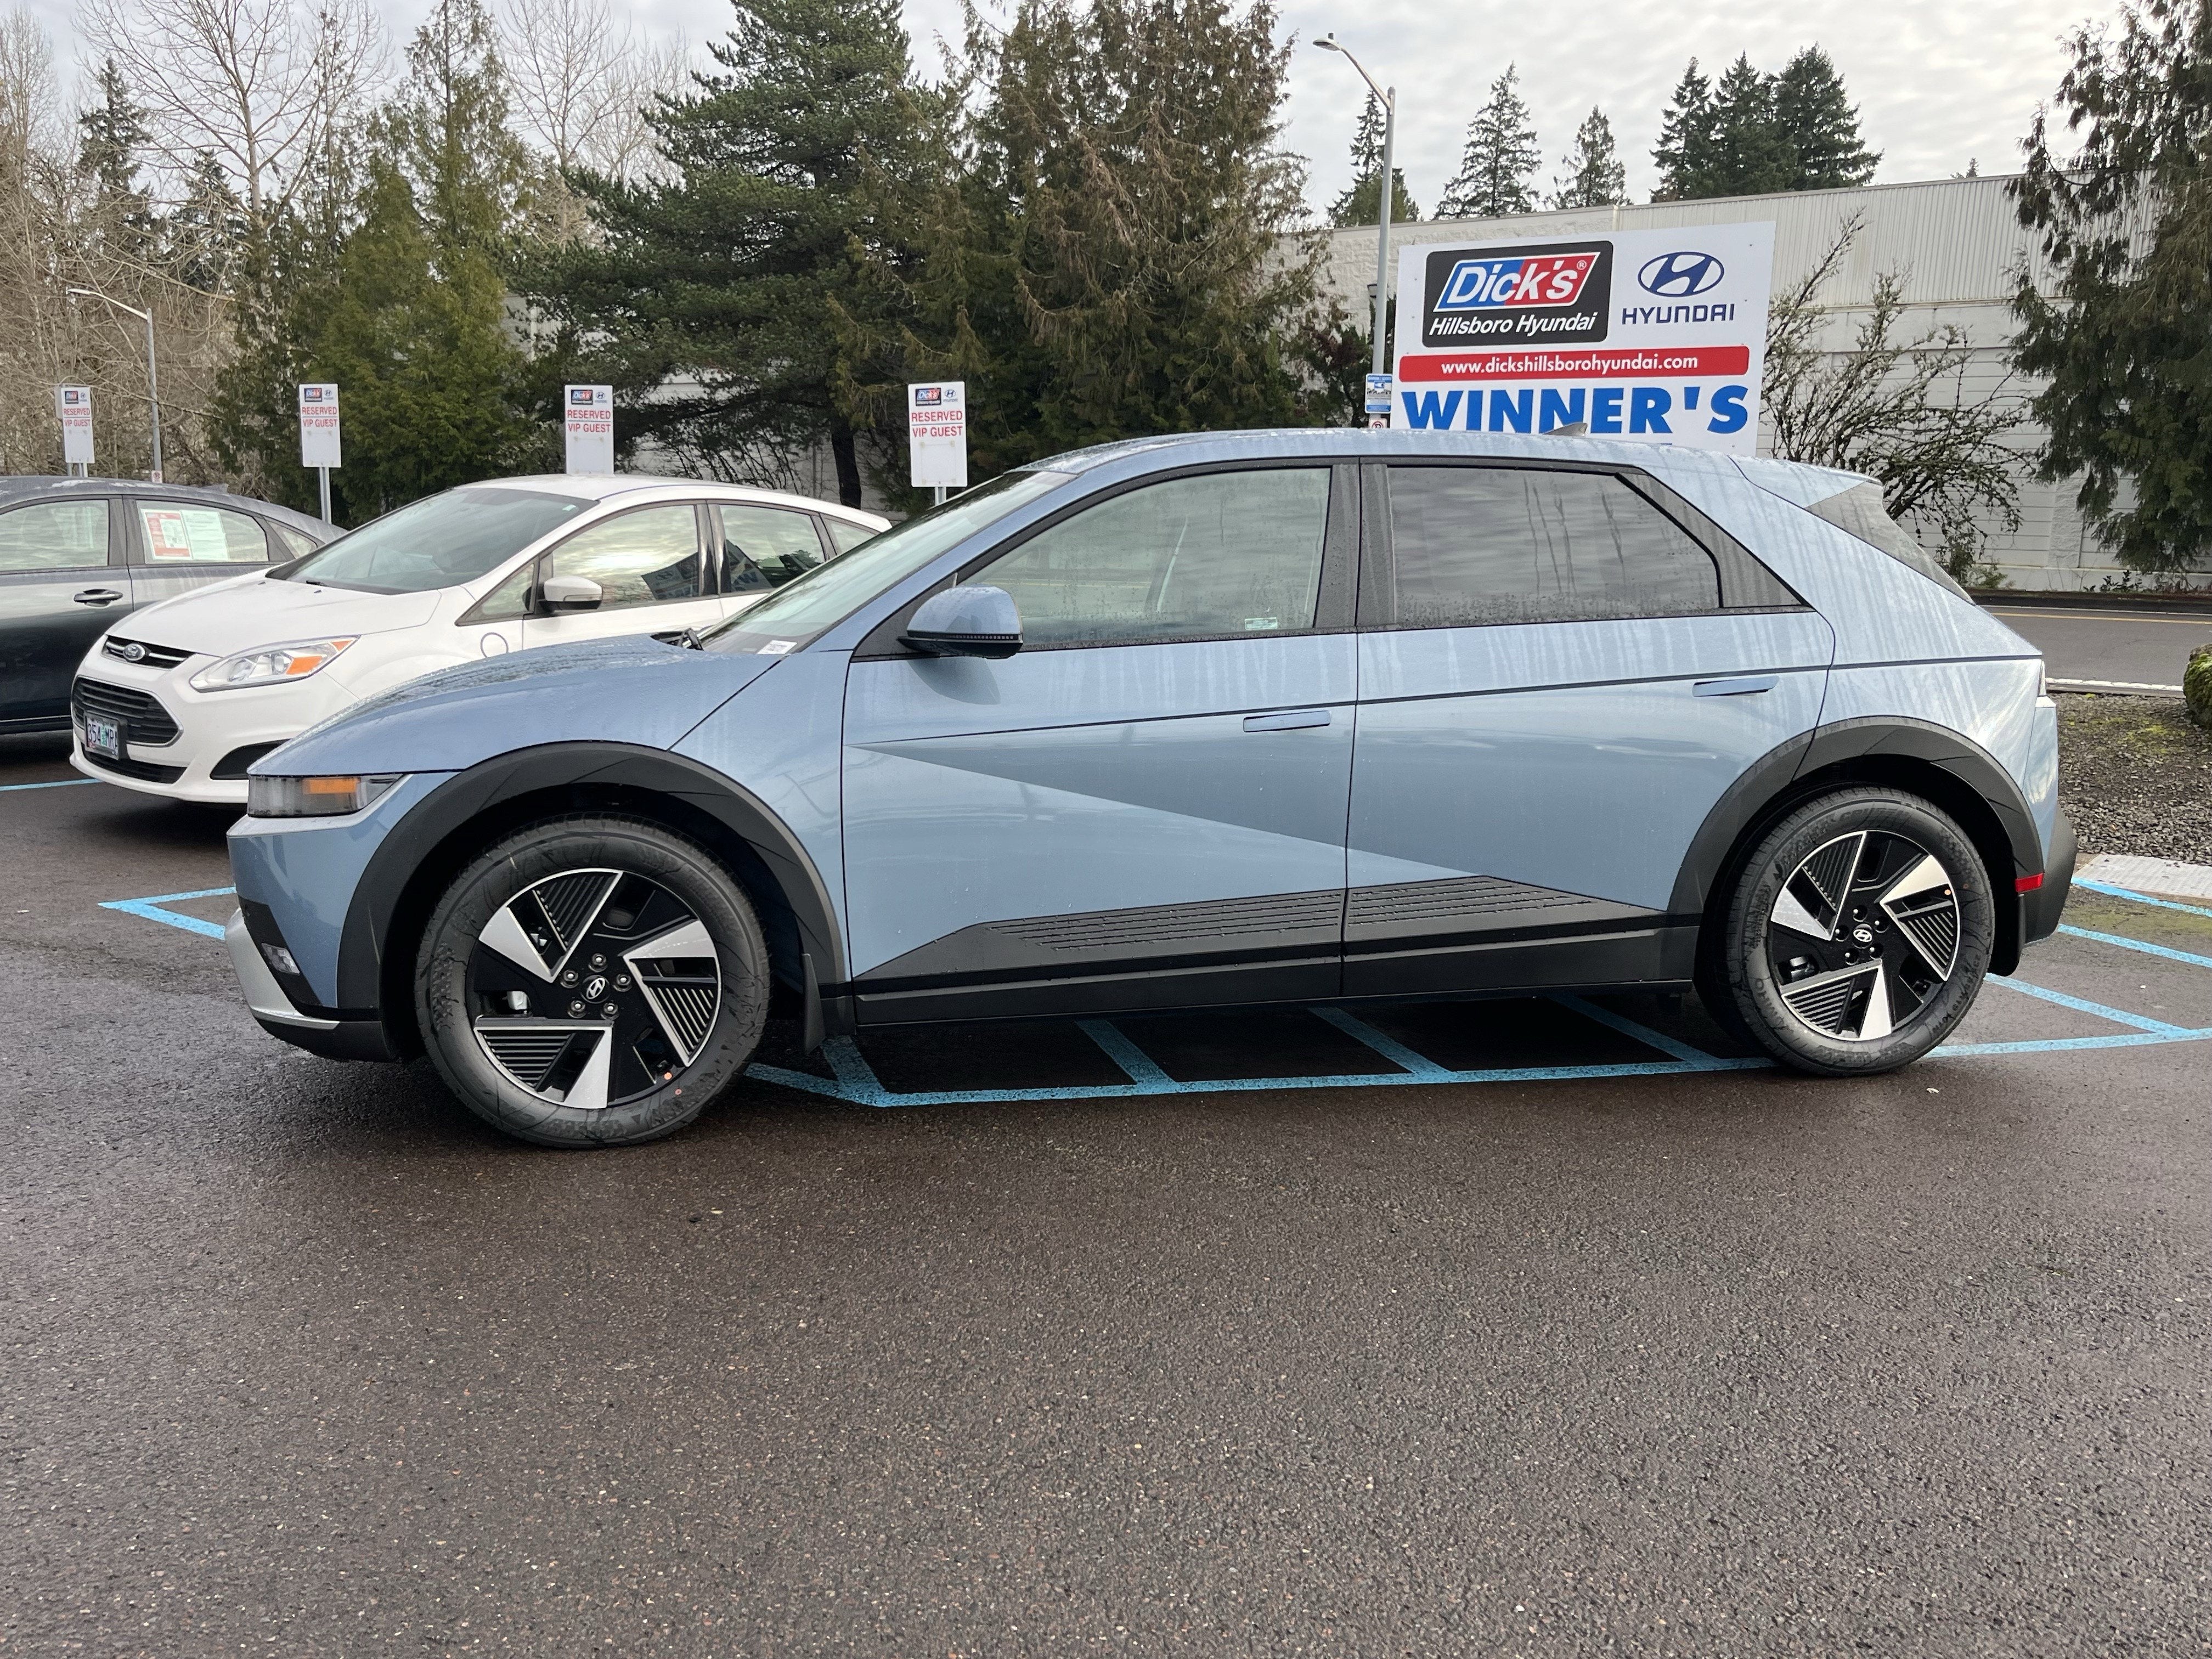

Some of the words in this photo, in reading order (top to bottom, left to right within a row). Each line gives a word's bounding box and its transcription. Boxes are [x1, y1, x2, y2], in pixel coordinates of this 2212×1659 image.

[1446, 260, 1578, 303] Dick's
[1622, 303, 1735, 325] HYUNDAI
[1429, 316, 1513, 335] Hillsboro
[1516, 312, 1598, 336] Hyundai
[1441, 353, 1698, 376] www.dickshillsborohyundai.com
[63, 408, 91, 416] RESERVED
[302, 407, 337, 415] RESERVED
[567, 410, 611, 419] RESERVED
[1401, 385, 1749, 434] WINNER'S
[911, 411, 963, 422] RESERVED
[303, 419, 313, 427] VIP
[315, 419, 338, 427] GUEST
[568, 424, 580, 432] VIP
[583, 424, 611, 433] GUEST
[912, 427, 927, 437] VIP
[930, 426, 963, 437] GUEST
[88, 723, 101, 744] 354
